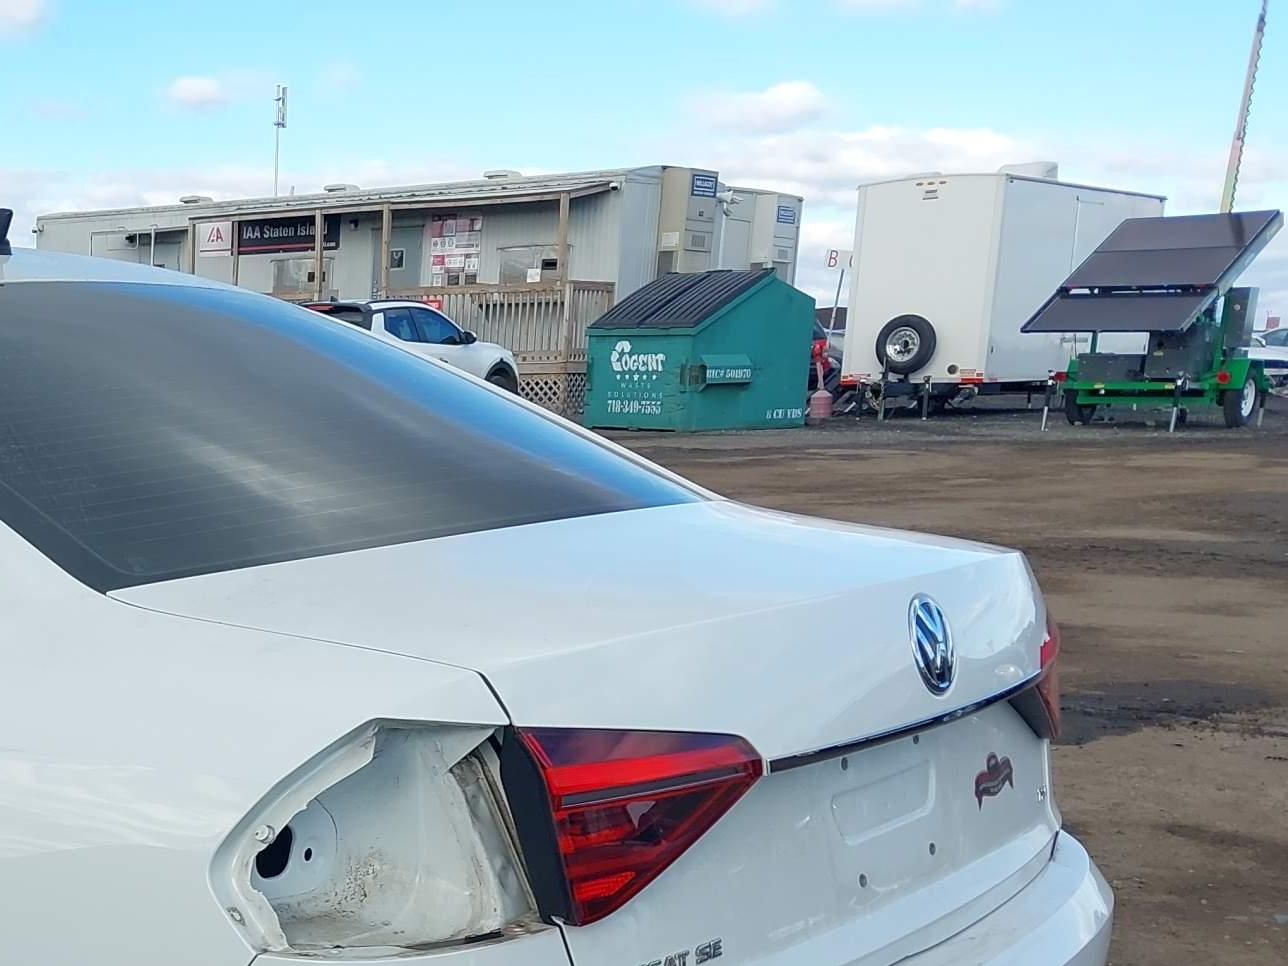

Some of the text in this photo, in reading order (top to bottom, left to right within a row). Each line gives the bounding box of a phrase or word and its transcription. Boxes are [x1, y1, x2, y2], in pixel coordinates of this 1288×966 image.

[243, 221, 328, 240] IAA Staten Islad
[620, 382, 651, 390] WASTE
[607, 391, 663, 399] SOLUTIONS
[607, 400, 662, 415] 718-349-7555
[773, 408, 785, 419] CU
[695, 937, 723, 966] SE
